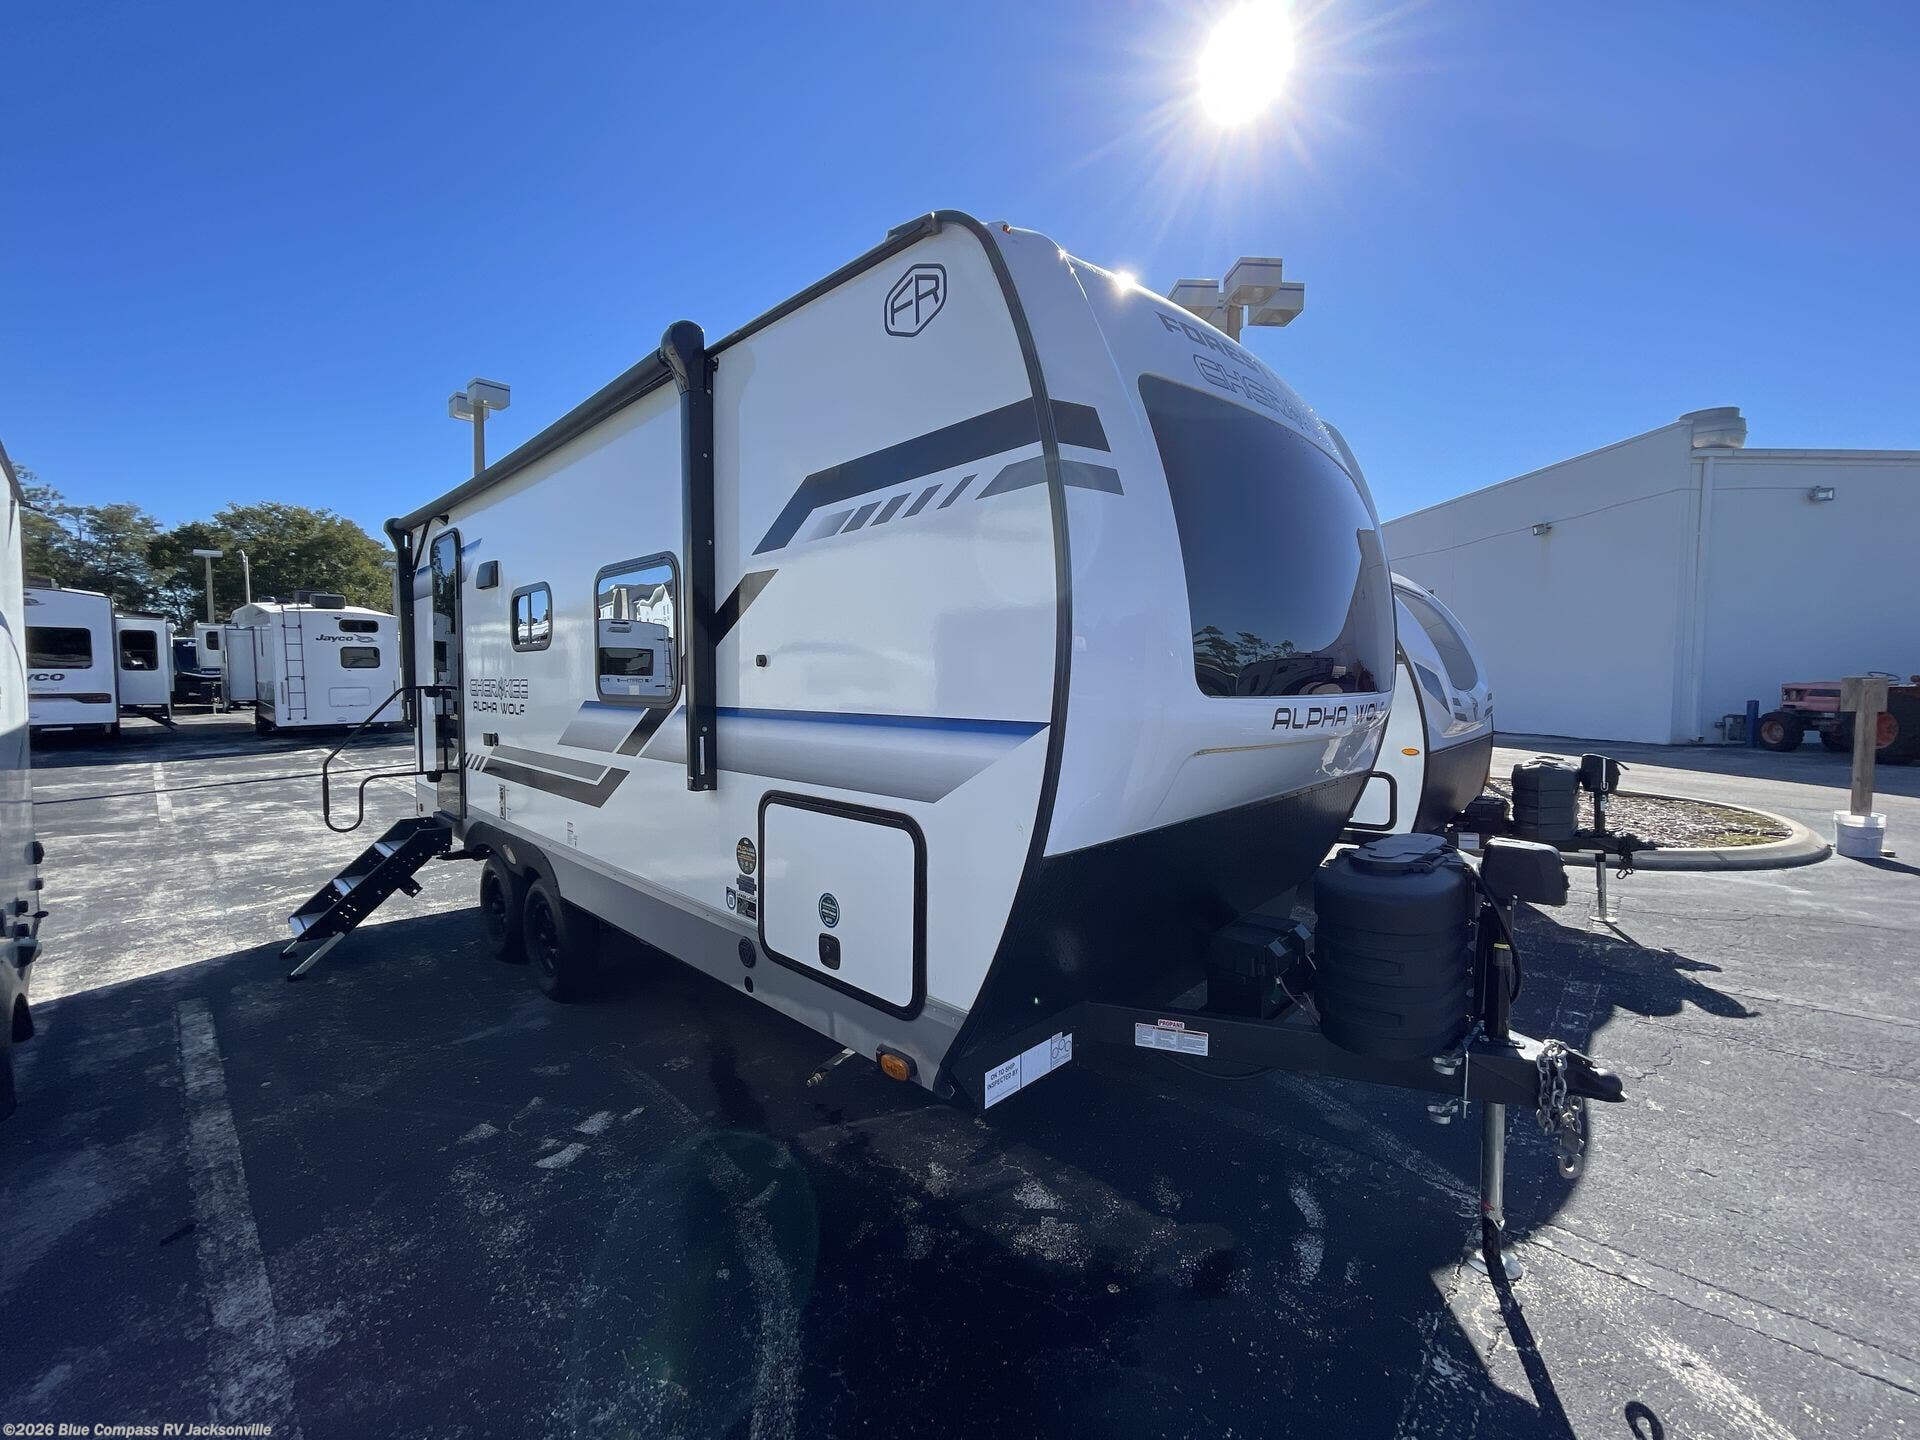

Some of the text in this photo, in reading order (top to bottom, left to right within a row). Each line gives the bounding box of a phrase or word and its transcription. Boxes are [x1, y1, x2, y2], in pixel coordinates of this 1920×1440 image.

[315, 633, 354, 643] Jayco
[27, 672, 65, 682] yco
[473, 700, 525, 716] ALPHA WOLF
[1271, 705, 1348, 730] ALPHA
[987, 1072, 1012, 1090] INSPECTED
